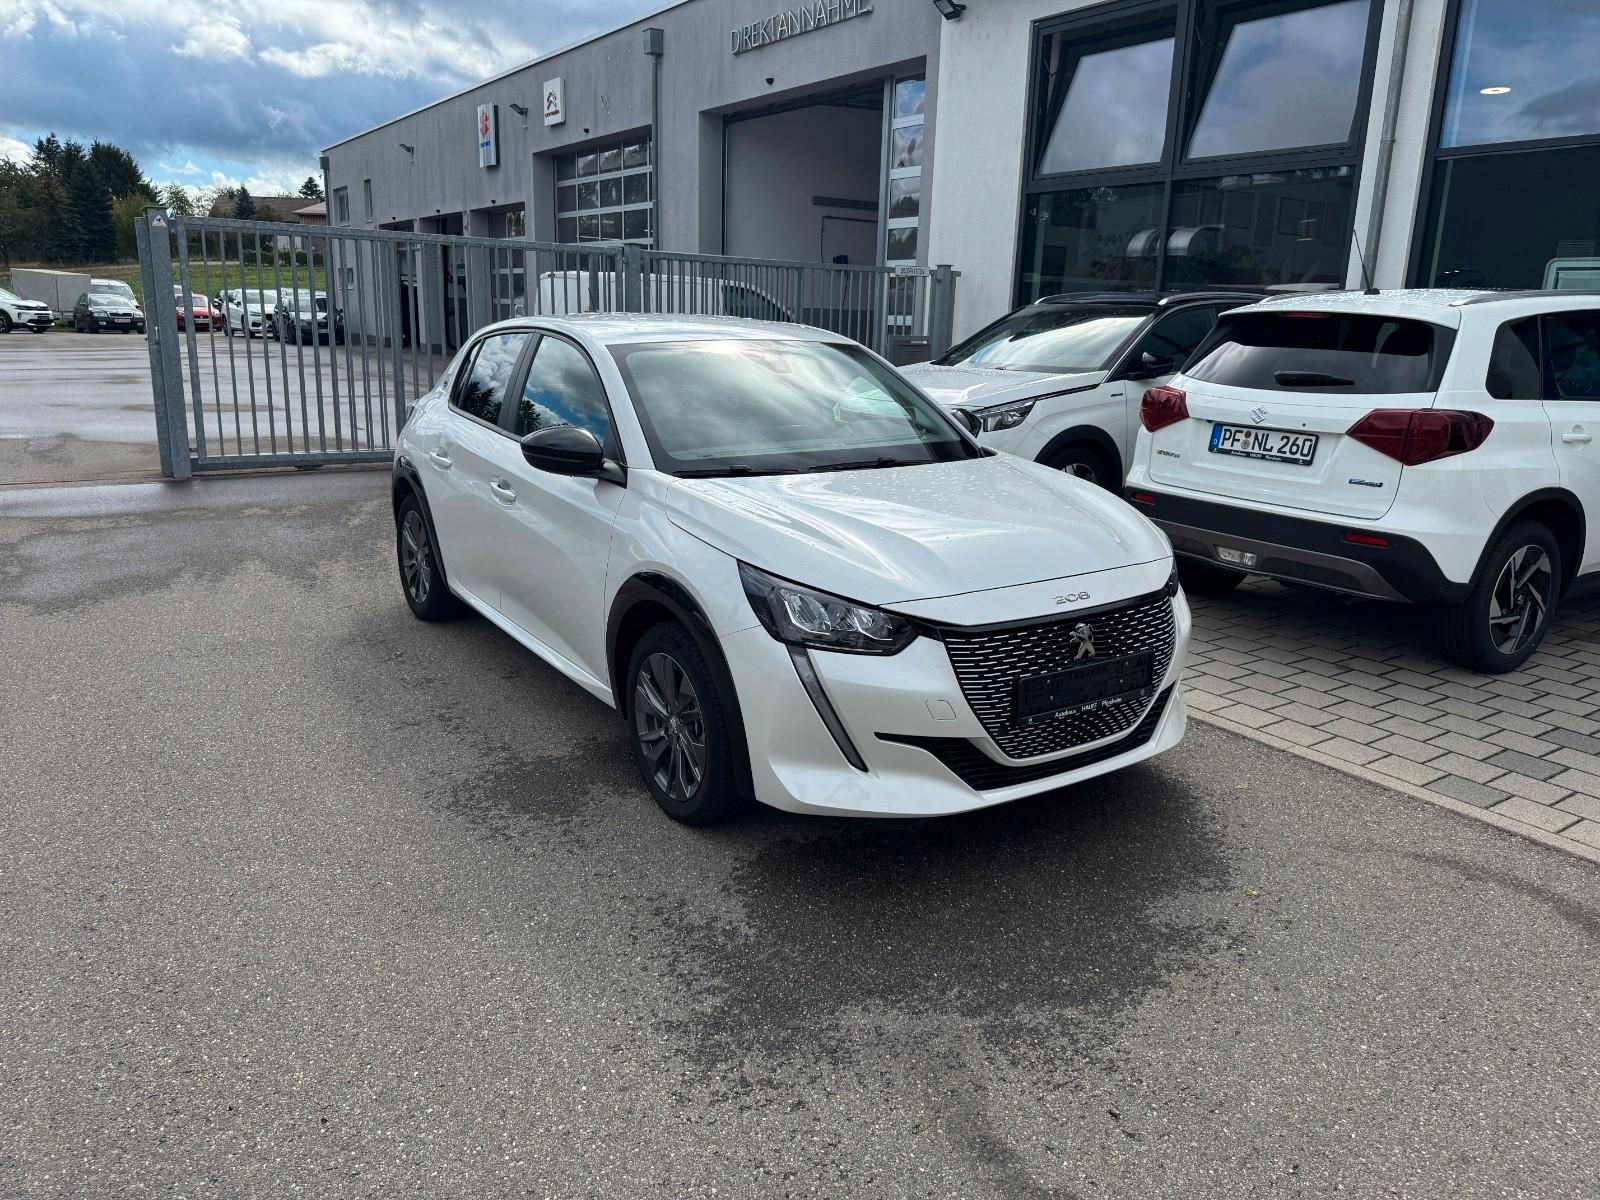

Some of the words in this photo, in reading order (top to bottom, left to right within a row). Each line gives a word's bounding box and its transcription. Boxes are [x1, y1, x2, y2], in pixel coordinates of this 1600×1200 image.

[1221, 428, 1244, 447] PF
[1251, 432, 1274, 452] NL
[1276, 435, 1314, 457] 260
[1053, 591, 1091, 605] 208
